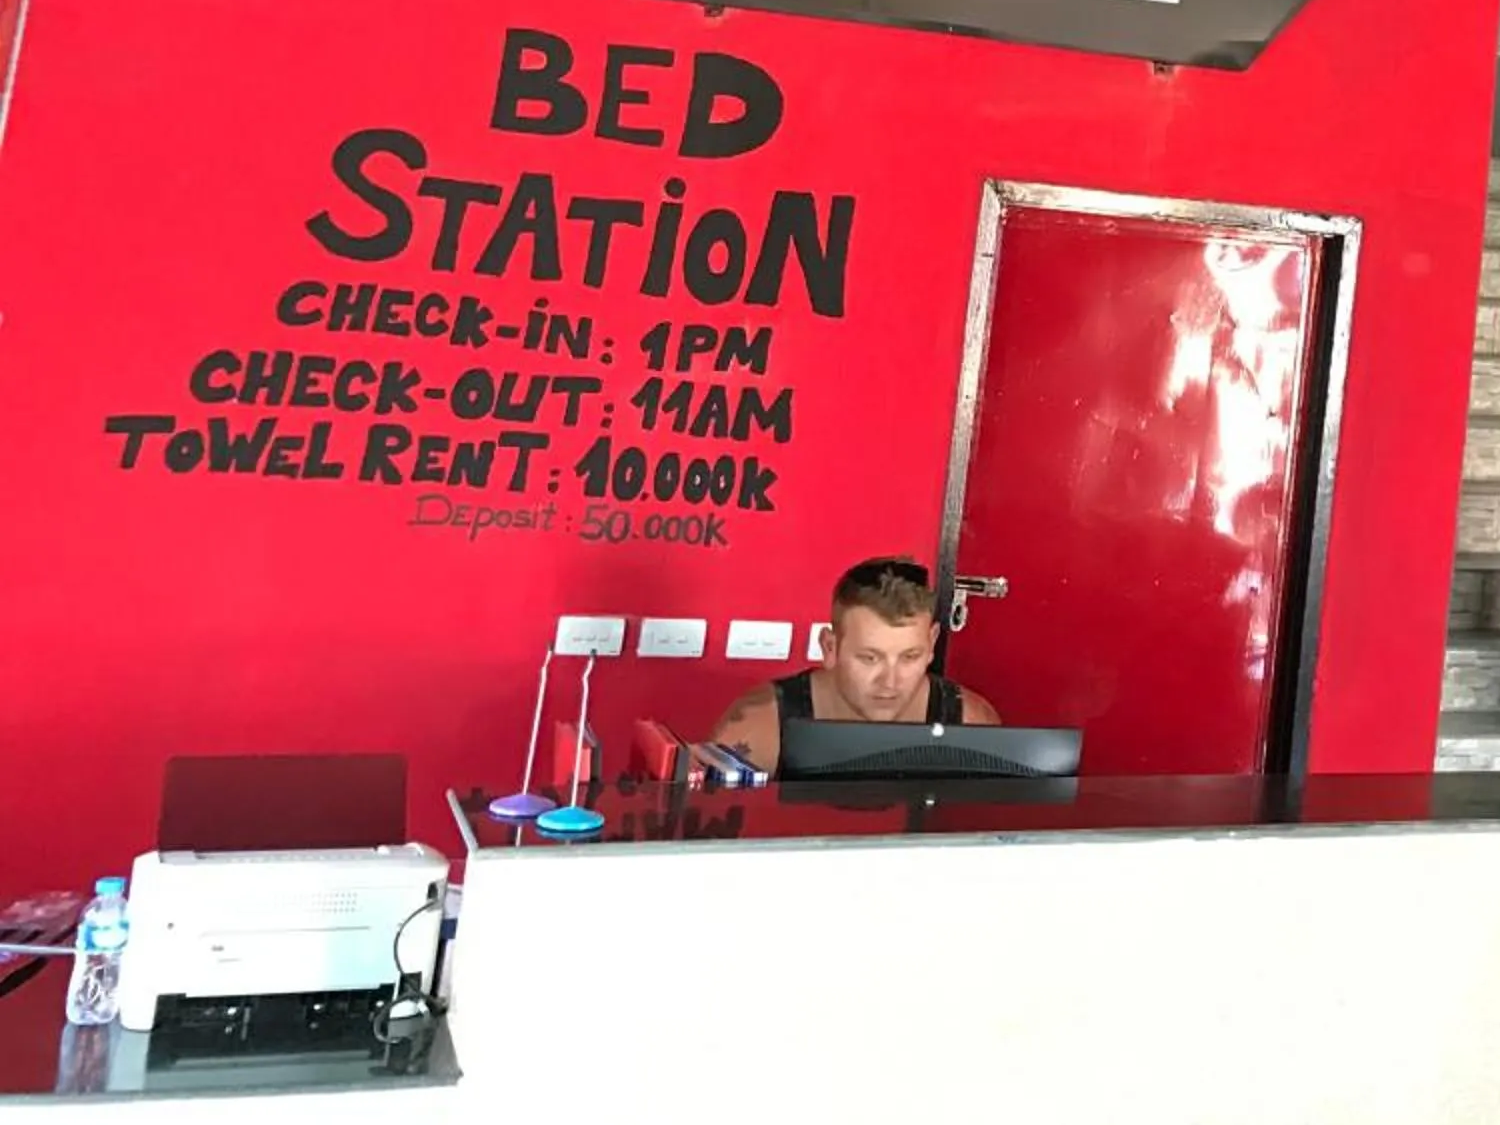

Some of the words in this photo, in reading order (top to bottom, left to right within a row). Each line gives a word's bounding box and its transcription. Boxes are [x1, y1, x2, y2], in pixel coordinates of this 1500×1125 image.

[490, 28, 785, 159] BED
[639, 320, 774, 375] 1PM
[630, 377, 794, 444] 11AM
[104, 414, 343, 480] TOWEL
